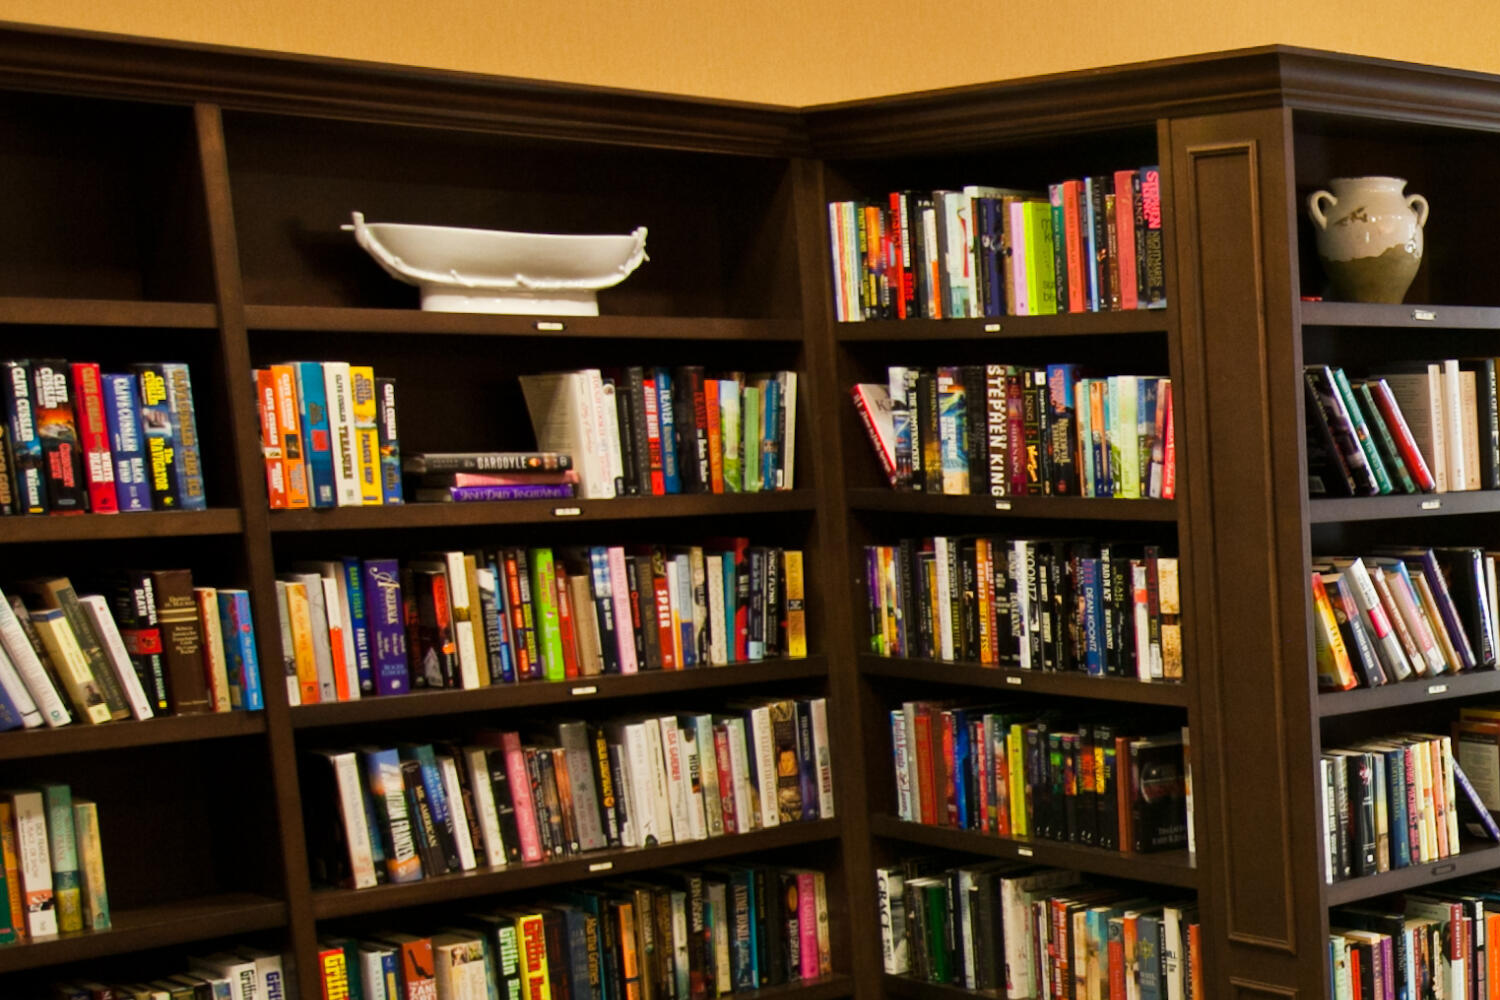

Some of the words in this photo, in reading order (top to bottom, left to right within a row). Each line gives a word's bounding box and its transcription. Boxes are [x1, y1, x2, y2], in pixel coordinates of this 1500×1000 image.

[1141, 182, 1151, 220] KING
[1146, 171, 1161, 229] STEPHEN
[1151, 230, 1163, 287] NIGHTMARES
[12, 367, 29, 398] CLIVE
[40, 367, 58, 409] CUSSLER
[56, 373, 69, 403] CLIVE
[113, 377, 131, 408] CLIVE
[264, 387, 275, 411] CLIVE
[384, 384, 395, 407] CLIVE
[1489, 372, 1497, 397] BOOK
[16, 399, 35, 442] CUSSLER
[986, 365, 1002, 447] STEPHEN
[1491, 398, 1498, 410] OF
[119, 408, 139, 452] CUSSLER
[386, 408, 398, 441] CUSSLER
[1058, 417, 1071, 464] NEEDFUL
[338, 425, 354, 480] TREASURE
[1050, 422, 1062, 464] THINGS
[88, 452, 104, 483] DEATH
[102, 451, 115, 482] WHITE
[149, 437, 169, 491] NAVIGATOR
[990, 453, 1005, 497] KING
[767, 550, 776, 576] VINCE
[1026, 550, 1037, 602] KOONTZ
[134, 588, 147, 617] DEATH
[143, 578, 158, 626] WRONGFUL
[657, 589, 671, 629] SPEER
[767, 577, 778, 605] FLYNN
[1085, 587, 1095, 613] DEAN
[355, 627, 368, 651] FAULT
[1087, 614, 1097, 652] KOONTZ
[359, 651, 371, 671] LINE
[666, 727, 678, 746] LISA
[668, 746, 681, 782] GARDNER
[688, 754, 700, 779] HIDE
[760, 735, 774, 780] ELIZABETH
[390, 820, 415, 864] FRANZEN
[420, 803, 438, 848] AMERICAN
[690, 878, 703, 898] JOHN
[877, 875, 891, 931] GRACE
[692, 898, 704, 933] GRISHAM
[498, 926, 519, 976] Griffin
[522, 917, 544, 973] Griffin
[585, 917, 598, 951] Martha
[588, 952, 602, 985] Grimes
